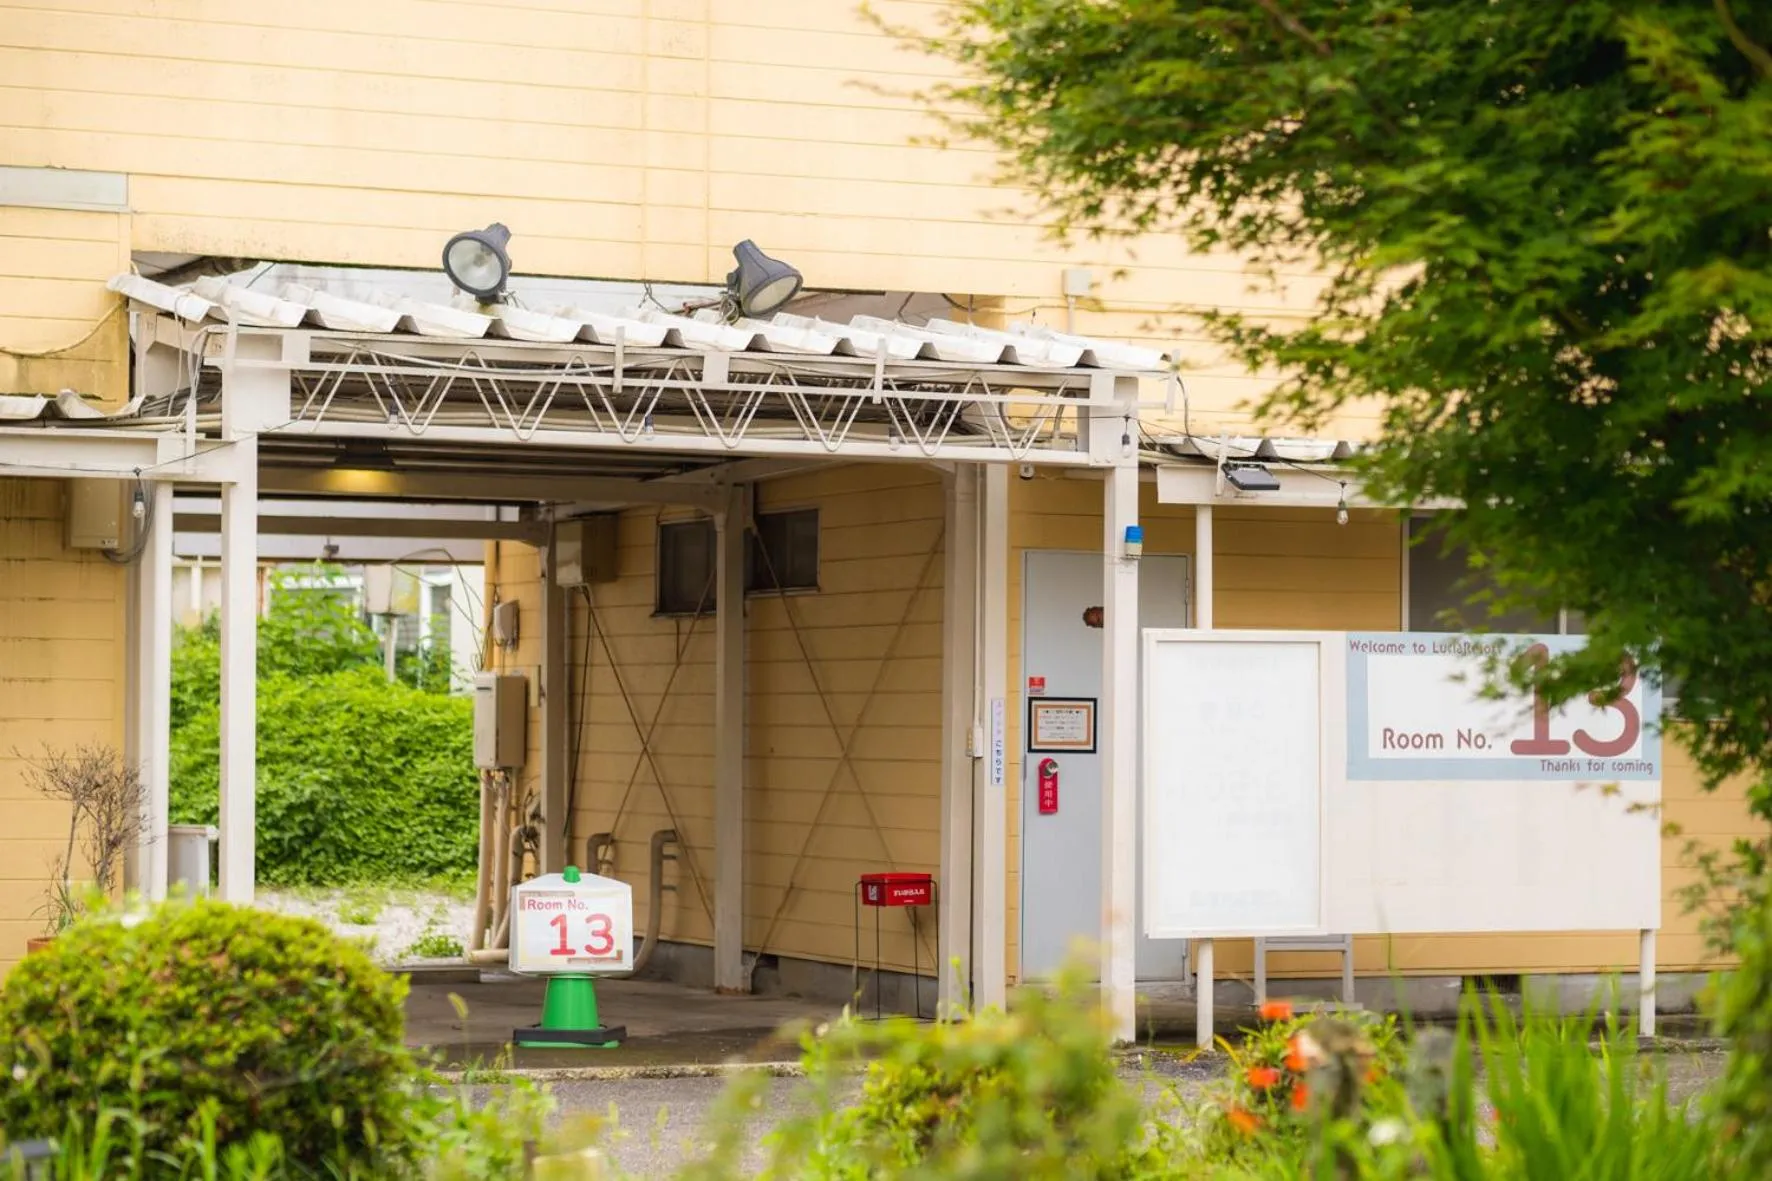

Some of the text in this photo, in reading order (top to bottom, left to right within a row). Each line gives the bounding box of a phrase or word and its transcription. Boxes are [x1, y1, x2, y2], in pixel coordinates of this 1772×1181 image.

[1349, 640, 1406, 653] Welcome
[1412, 642, 1426, 654] to
[1510, 642, 1640, 757] 13
[1382, 727, 1493, 750] Room No.
[1540, 759, 1654, 775] Thanks for coming
[527, 899, 588, 910] Room No.
[549, 913, 614, 955] 13
